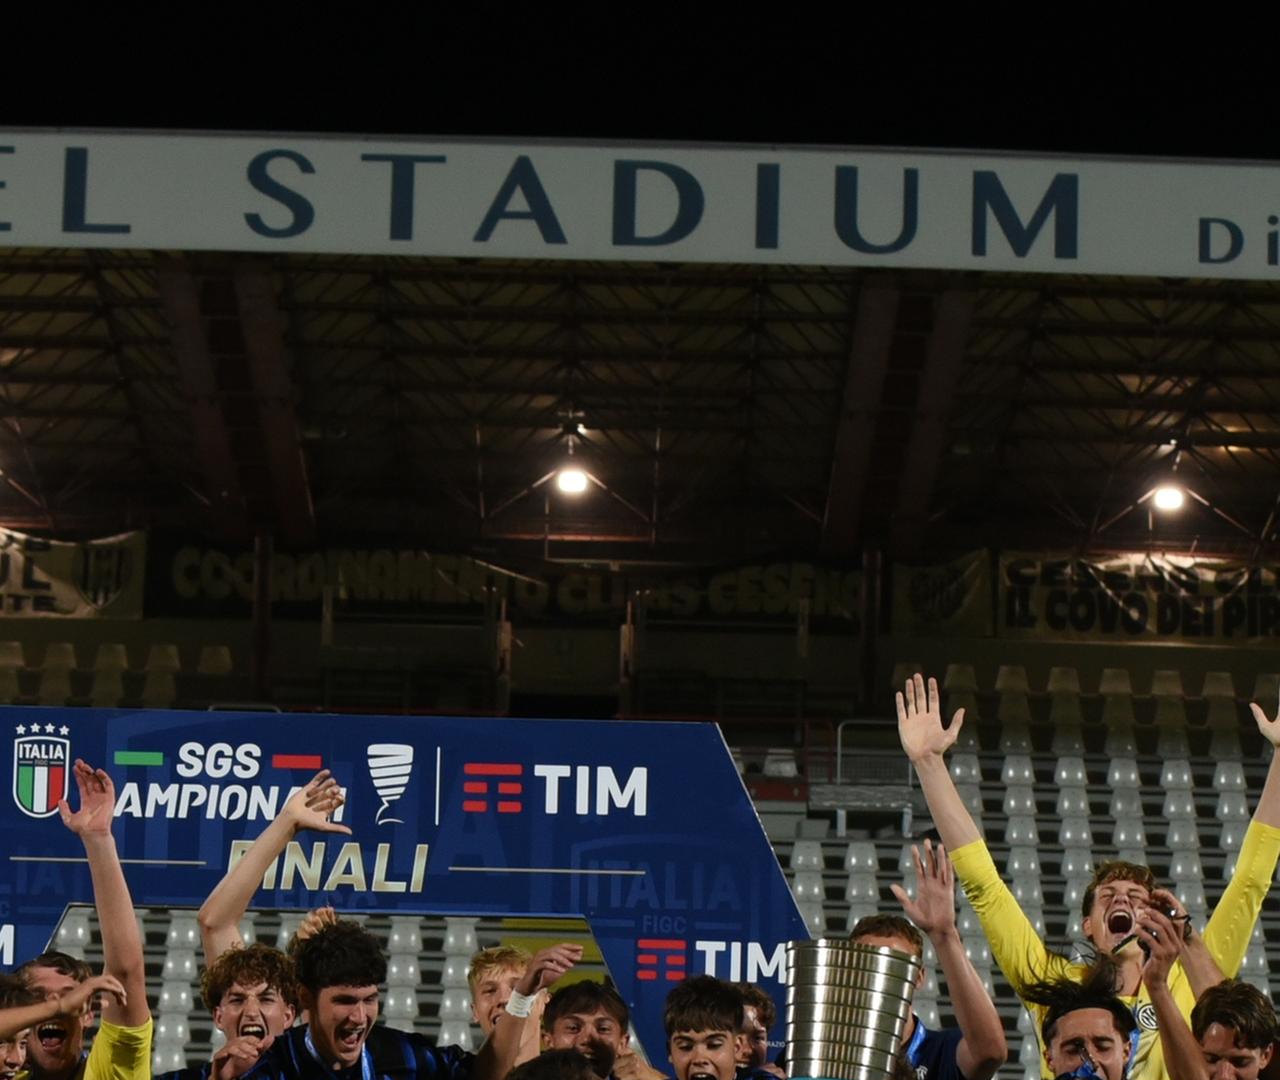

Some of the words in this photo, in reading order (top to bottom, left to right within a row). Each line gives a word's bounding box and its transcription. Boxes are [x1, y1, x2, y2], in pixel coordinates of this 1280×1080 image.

[243, 147, 1080, 260] STADIUM
[1045, 590, 1149, 637] COVO
[18, 744, 64, 759] ITALIA
[176, 741, 262, 779] SGS
[533, 764, 648, 816] TIM
[695, 940, 787, 984] TIM
